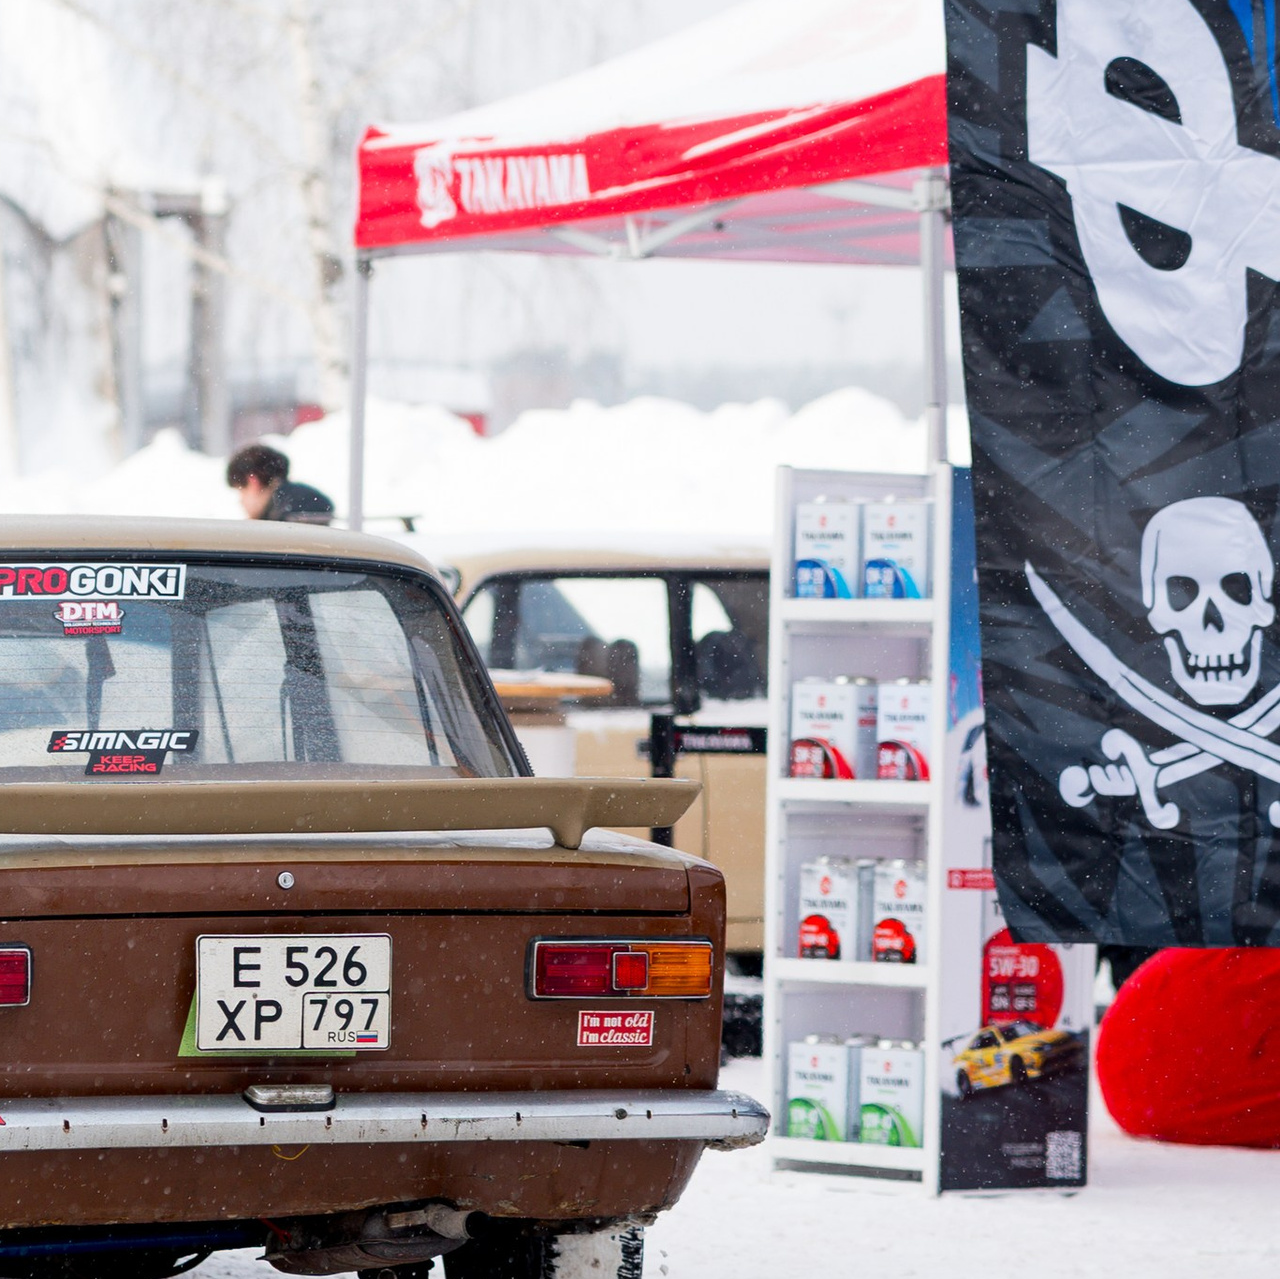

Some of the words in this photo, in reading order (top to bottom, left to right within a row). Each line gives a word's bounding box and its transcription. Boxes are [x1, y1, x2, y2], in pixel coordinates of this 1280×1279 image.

[453, 153, 591, 214] TAKAYAMA
[59, 602, 118, 620] DTM
[64, 626, 121, 634] MOTORSPORT
[63, 732, 191, 750] SIMAGIC
[100, 756, 146, 764] KEEP
[93, 763, 157, 772] RACING
[285, 946, 367, 987] 526
[309, 999, 379, 1030] 797
[583, 1014, 601, 1027] I'm
[604, 1016, 622, 1027] not
[625, 1013, 649, 1027] old
[327, 1031, 356, 1042] RUS
[582, 1031, 599, 1043] I'm
[600, 1029, 648, 1043] classic
